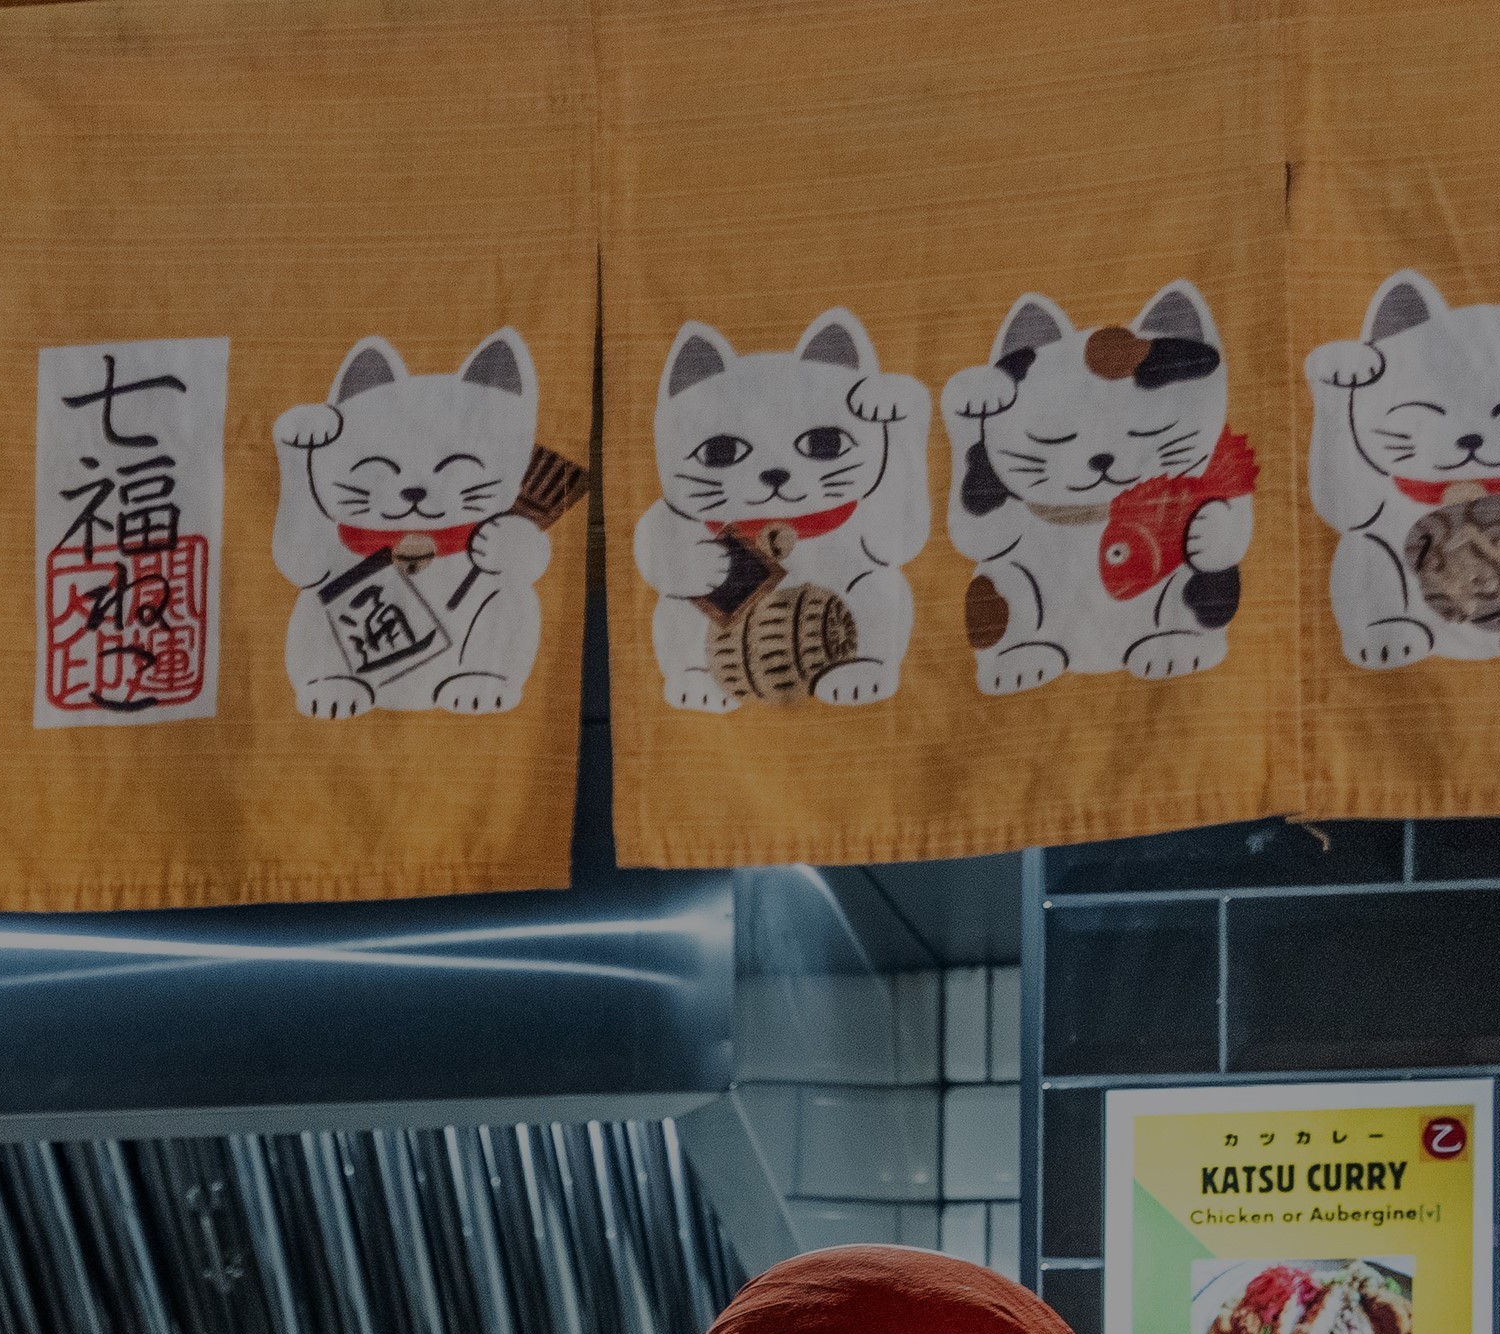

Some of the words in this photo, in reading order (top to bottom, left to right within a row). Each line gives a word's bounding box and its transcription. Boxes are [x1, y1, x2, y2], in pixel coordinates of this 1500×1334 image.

[57, 353, 188, 712] 七福ねこ
[1224, 1130, 1384, 1147] カツカレー
[1202, 1165, 1296, 1195] KATSU
[1307, 1161, 1408, 1192] CURRY
[1190, 1207, 1274, 1226] Chicken
[1282, 1209, 1302, 1223] or
